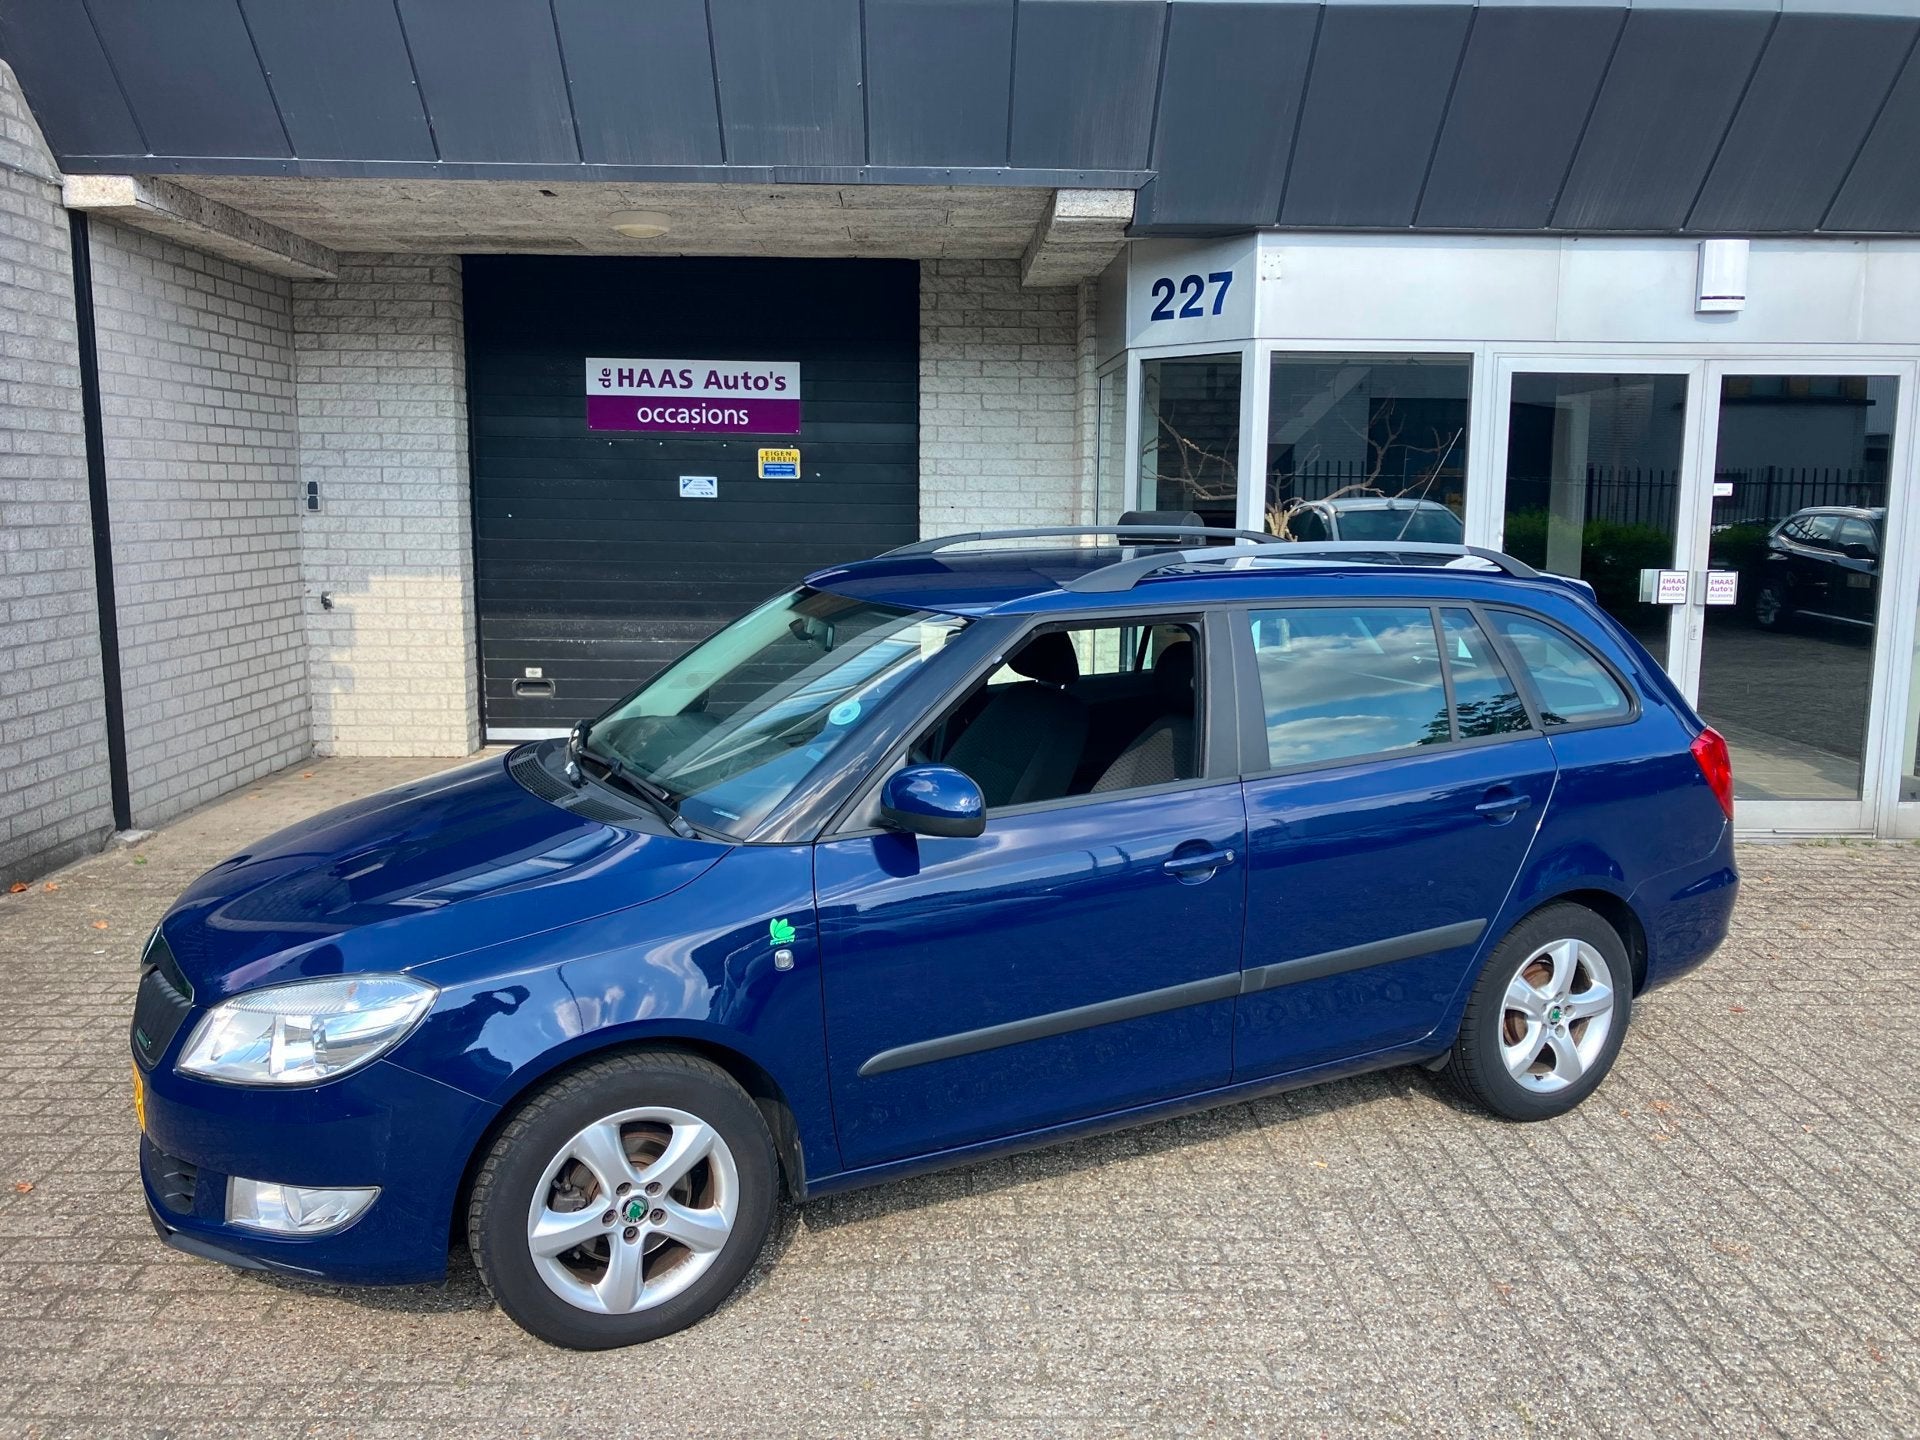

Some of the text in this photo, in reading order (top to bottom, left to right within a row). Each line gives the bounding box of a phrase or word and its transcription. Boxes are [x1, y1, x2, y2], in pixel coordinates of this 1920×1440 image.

[1151, 271, 1233, 321] 227
[598, 368, 786, 391] de HAAS Auto's
[637, 403, 749, 424] occasions
